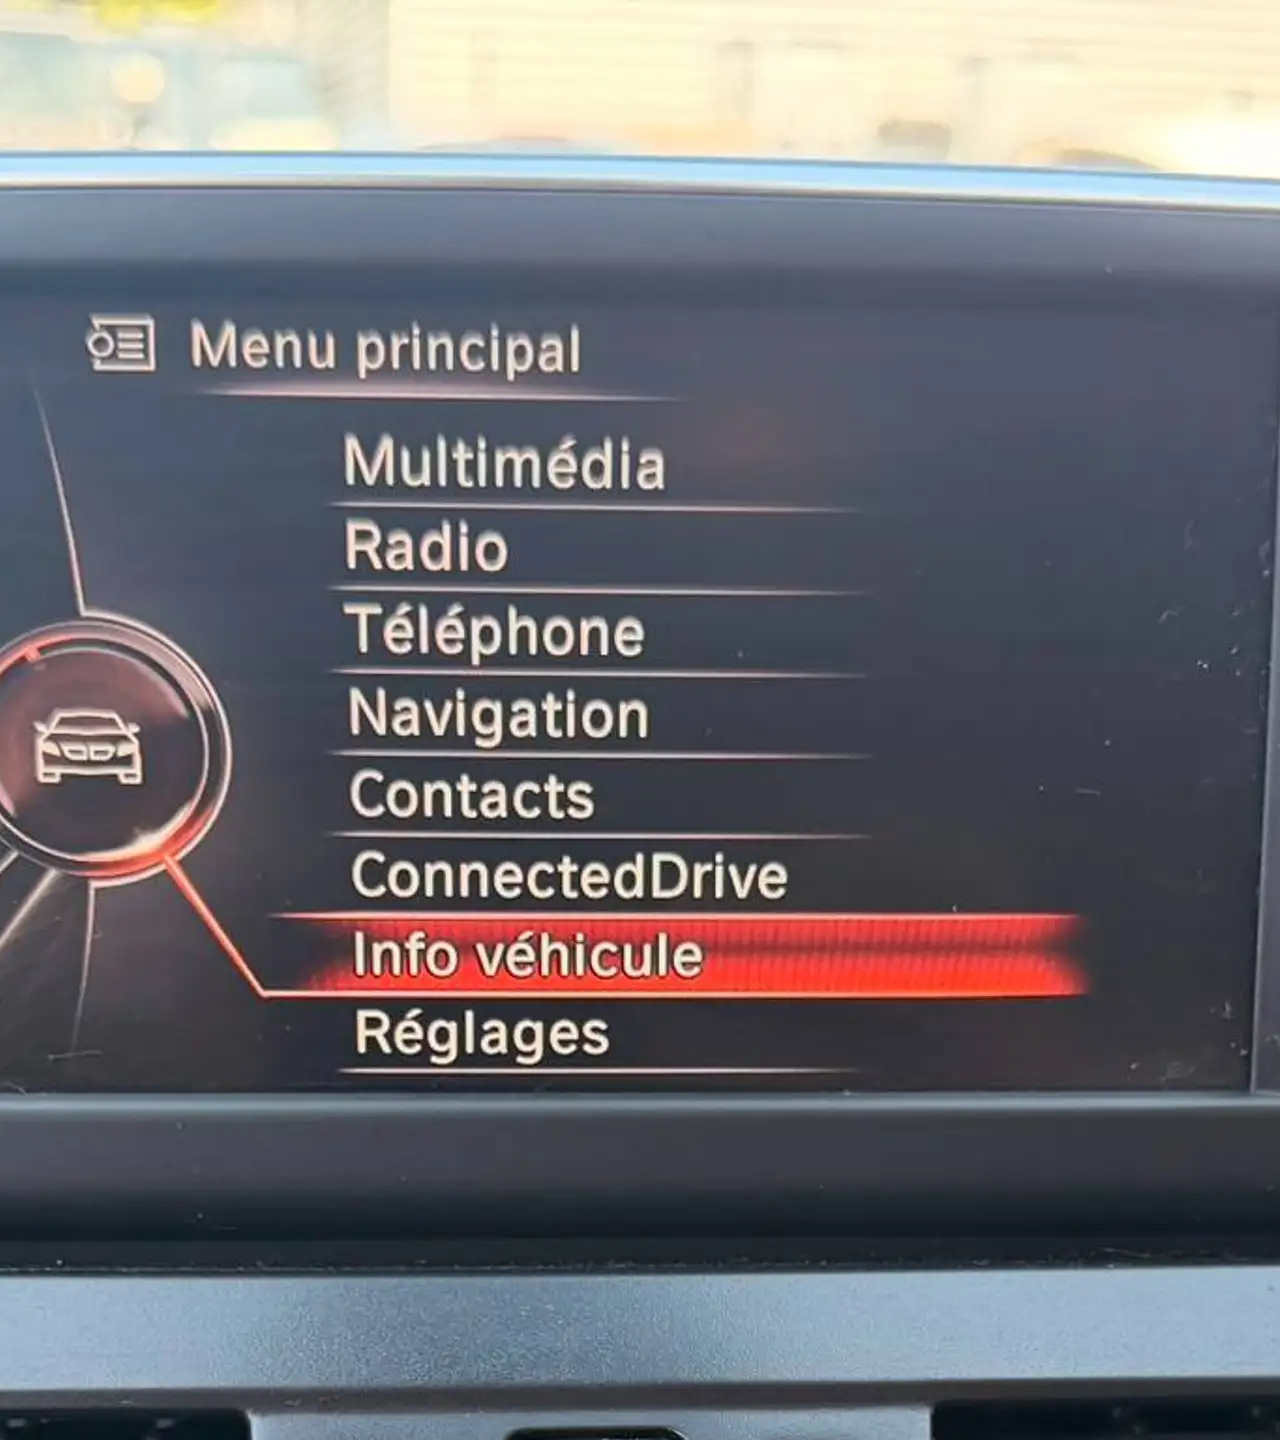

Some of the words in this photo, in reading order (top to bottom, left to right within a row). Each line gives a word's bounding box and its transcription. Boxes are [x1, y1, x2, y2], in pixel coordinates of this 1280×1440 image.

[191, 320, 336, 370] Menu
[355, 322, 580, 383] principal
[344, 433, 666, 491] Multimédia
[345, 518, 509, 573] Radio
[344, 601, 646, 665] Téléphone
[349, 686, 649, 749] Navigation
[350, 768, 595, 820] Contacts
[352, 849, 789, 900] ConnectedDrive
[355, 930, 459, 978] Info
[475, 929, 704, 978] véhicule
[356, 1007, 611, 1066] Réglages
